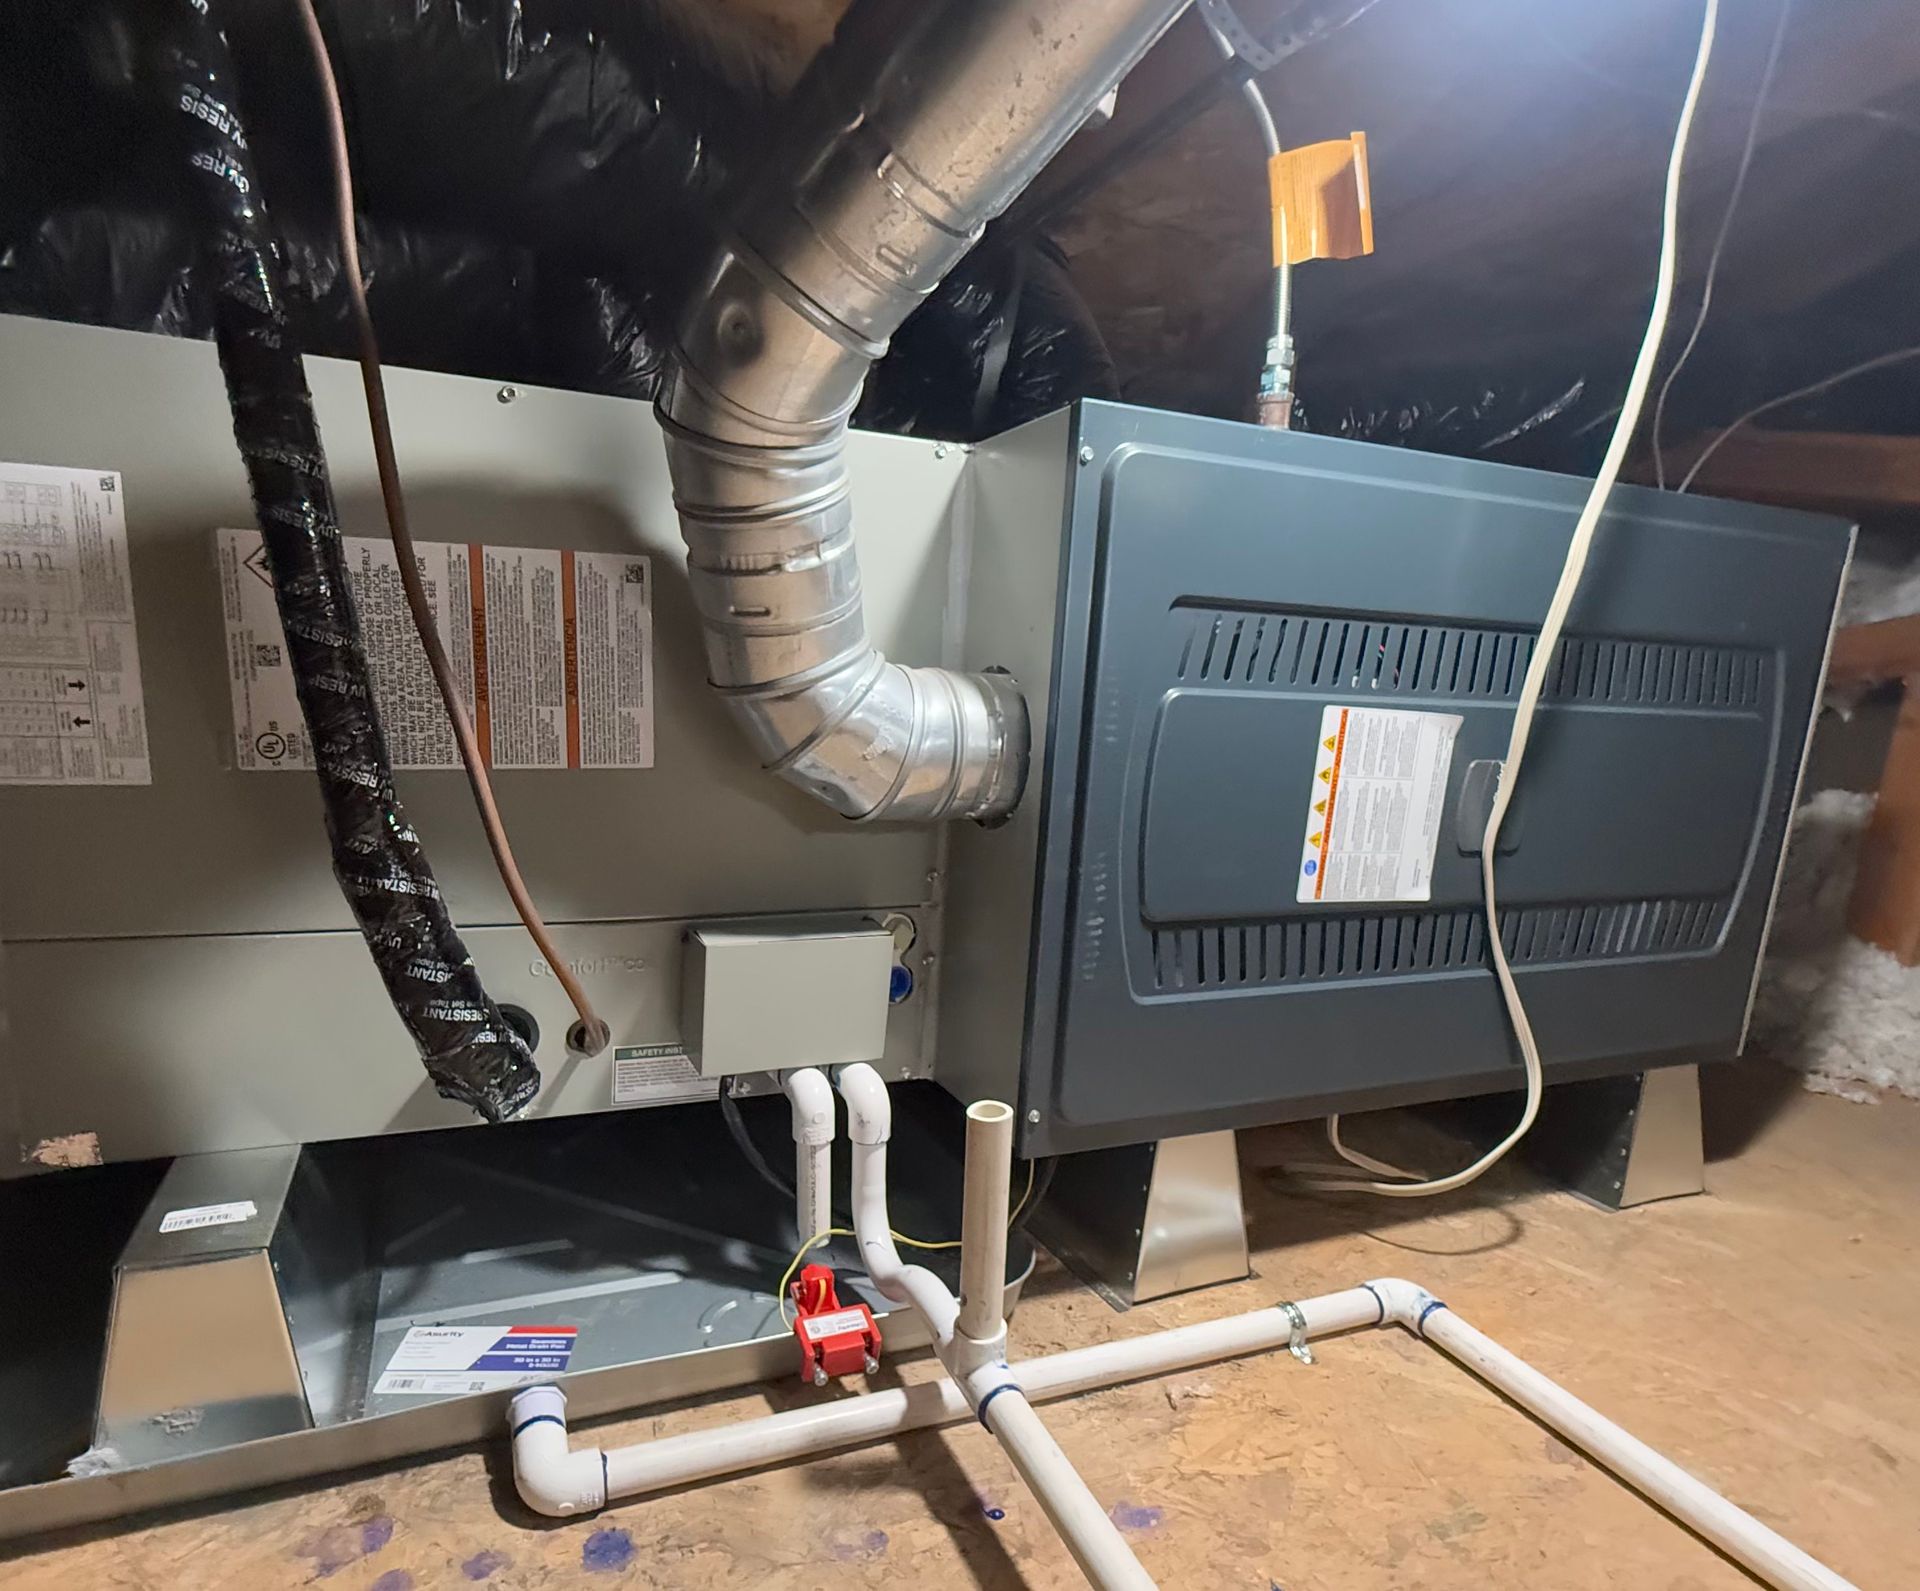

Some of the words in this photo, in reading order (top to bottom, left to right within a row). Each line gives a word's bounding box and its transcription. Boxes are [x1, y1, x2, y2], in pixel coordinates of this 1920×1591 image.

[362, 547, 372, 598] PROPERLY
[381, 564, 390, 584] FOR
[416, 556, 426, 578] FOR
[372, 567, 382, 598] LOCAL
[390, 570, 400, 611] DEVICES
[428, 580, 436, 599] SEE
[354, 571, 366, 624] PUNCTURE
[365, 602, 374, 614] OF
[374, 602, 383, 616] OR
[382, 586, 392, 616] GUIDE
[366, 617, 376, 658] DISPOSE
[376, 618, 386, 661] FEDERAL
[384, 618, 396, 675] INSTALLERS
[394, 613, 404, 662] AUXILIARY
[412, 636, 421, 645] IN
[404, 637, 414, 688] POTENTIAL
[474, 606, 488, 702] AVERTISSEMENT
[564, 618, 576, 698] ADVERTENCIA
[378, 664, 387, 687] WITH
[414, 648, 424, 698] INSTALLED
[388, 678, 397, 696] SEE
[398, 694, 408, 722] ROOM
[408, 700, 416, 712] BE
[416, 700, 425, 712] BE
[434, 702, 443, 720] THE
[268, 721, 279, 732] US
[408, 714, 416, 732] MAY
[417, 715, 426, 732] NOT
[426, 706, 434, 731] THAN
[436, 722, 444, 744] WITH
[263, 740, 279, 754] UL
[286, 733, 297, 759] LISTED
[400, 725, 410, 765] MINIMUM
[410, 734, 418, 764] WHICH
[418, 736, 428, 764] SHALL
[428, 734, 437, 764] OTHER
[436, 746, 446, 764] USE
[422, 1006, 483, 1021] RESISTANT
[429, 999, 450, 1008] Tape
[450, 1000, 465, 1008] Set
[632, 1048, 663, 1058] SAFETY
